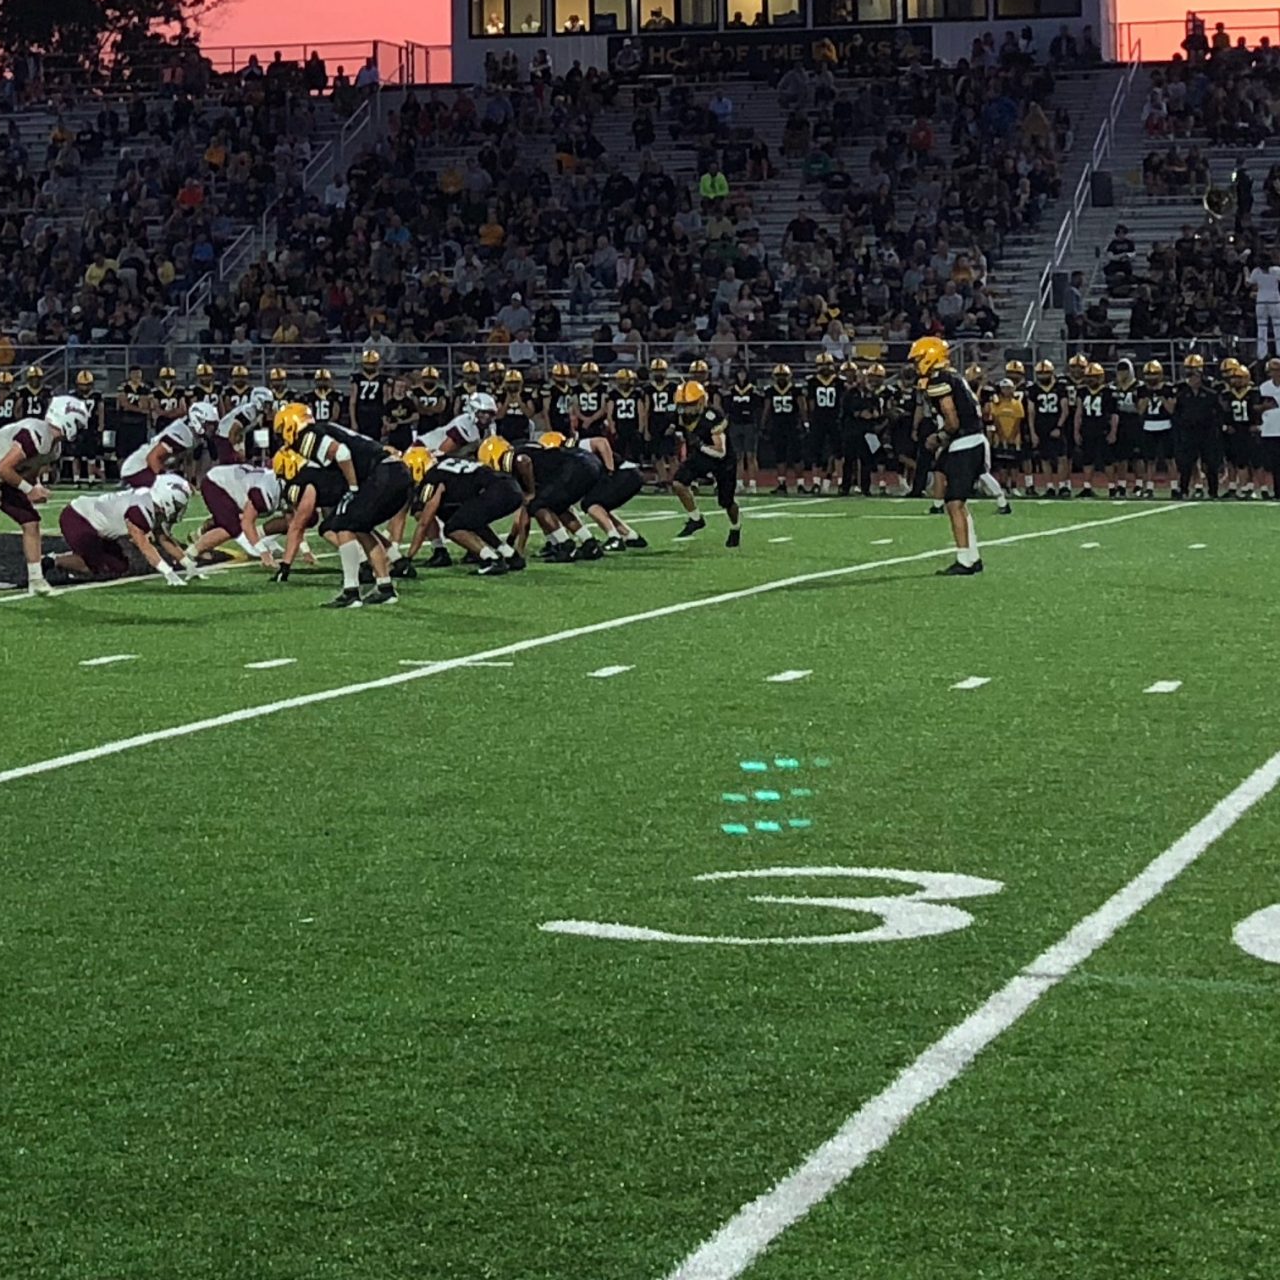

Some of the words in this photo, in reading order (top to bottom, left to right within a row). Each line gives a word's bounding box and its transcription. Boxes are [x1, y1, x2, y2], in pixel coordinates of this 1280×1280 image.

[360, 381, 379, 400] 77
[816, 386, 836, 407] 60
[314, 400, 330, 420] 16
[616, 398, 635, 419] 23
[772, 396, 793, 413] 55
[1036, 393, 1058, 413] 32
[1083, 395, 1103, 417] 44
[1231, 400, 1250, 421] 21
[538, 866, 1005, 944] 3
